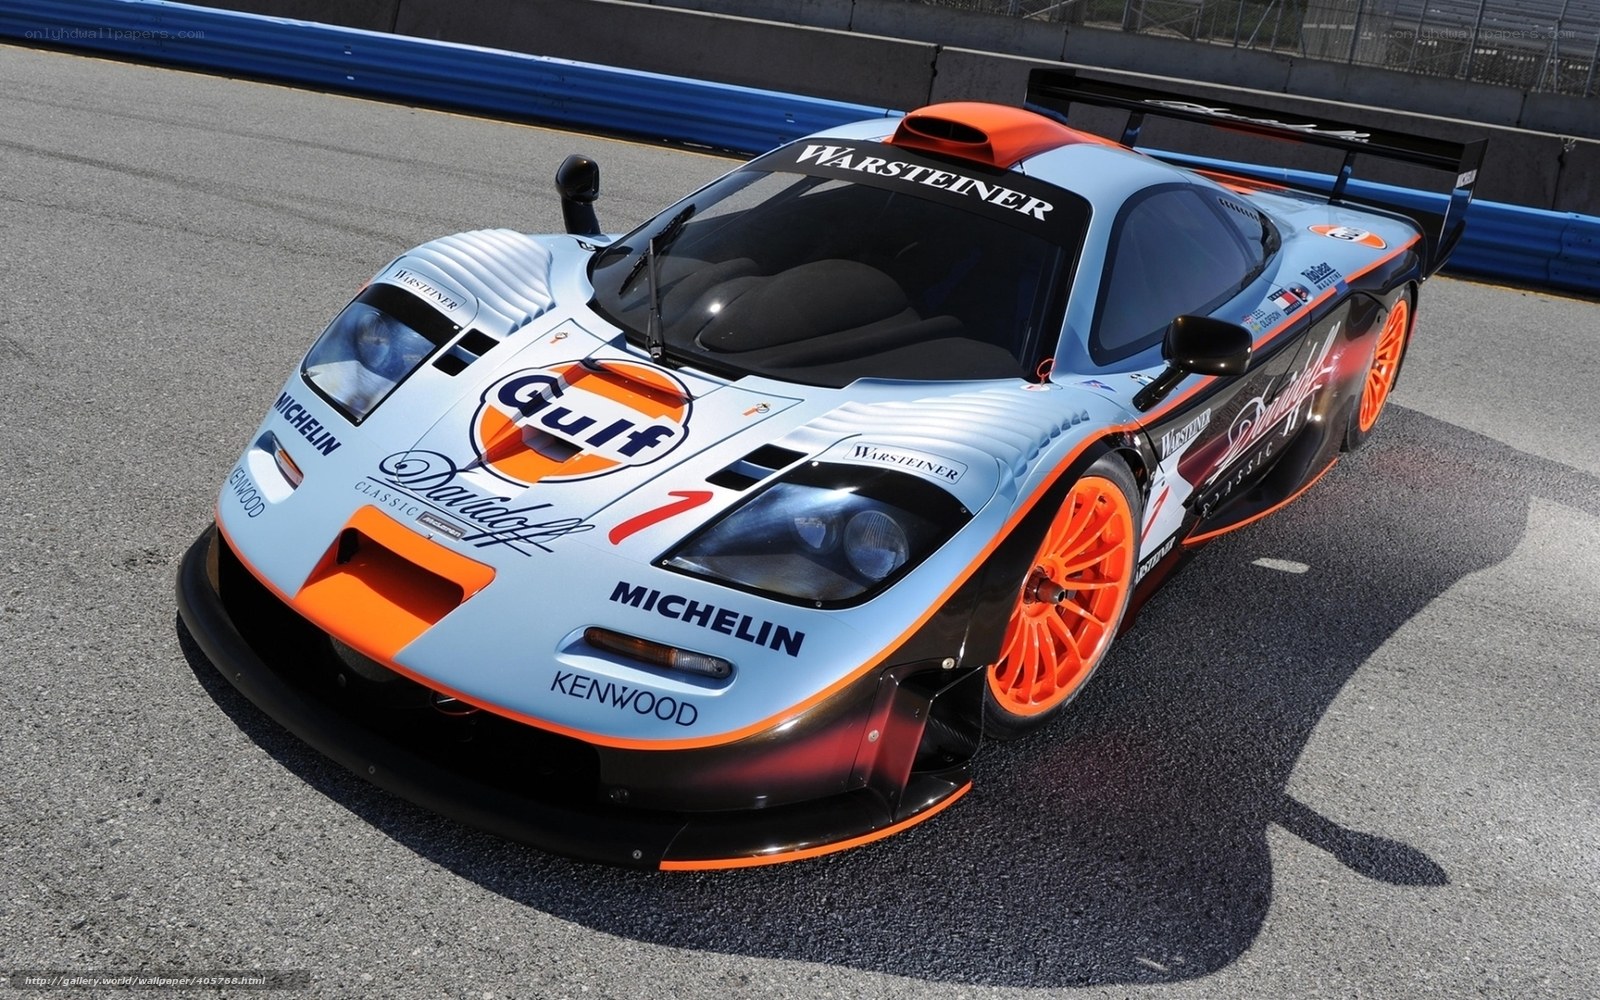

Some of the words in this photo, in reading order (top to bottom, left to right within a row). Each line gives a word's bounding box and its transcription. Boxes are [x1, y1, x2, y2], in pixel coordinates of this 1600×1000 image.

[795, 144, 1054, 221] WARSTEINER
[393, 269, 458, 310] WARSTEINER
[1315, 271, 1342, 290] MAGAZINE
[273, 391, 342, 457] MICHELIN
[497, 374, 675, 457] Gulf
[1160, 408, 1212, 456] WARSTEINER
[854, 445, 959, 480] WARSTEINER
[354, 481, 419, 516] CLASSIC
[367, 450, 595, 557] Davidoff
[608, 490, 714, 545] 1
[422, 515, 462, 538] McLaren
[1134, 536, 1176, 582] ARSTEINER
[609, 581, 805, 657] MICHELIN
[550, 671, 698, 726] KENWOOD
